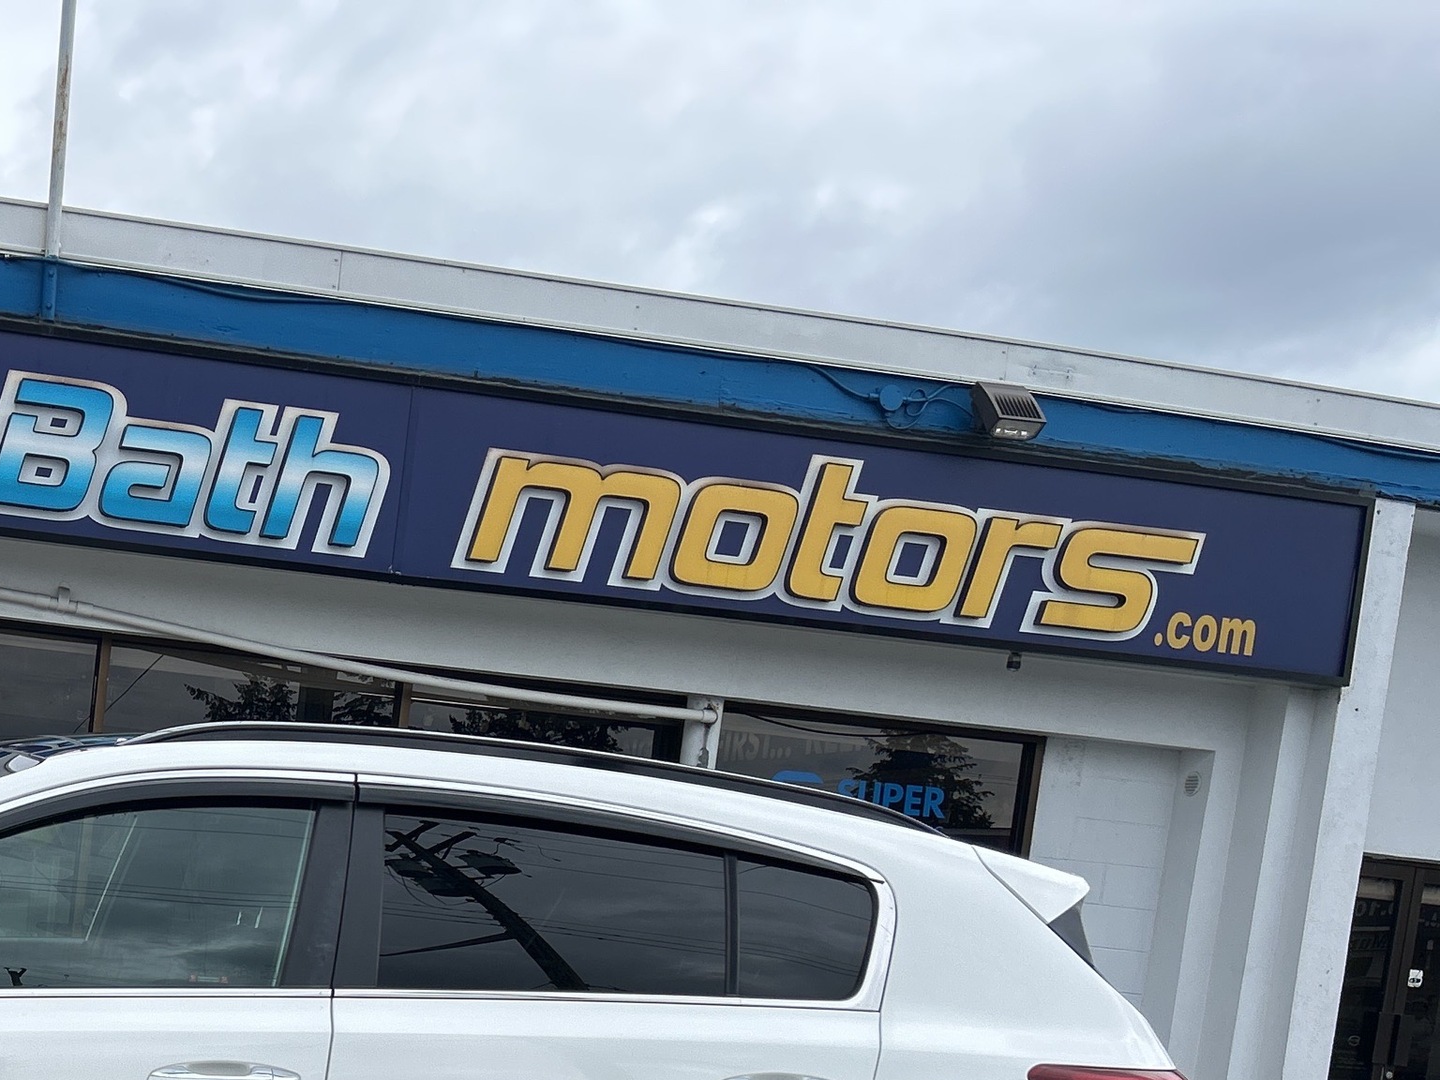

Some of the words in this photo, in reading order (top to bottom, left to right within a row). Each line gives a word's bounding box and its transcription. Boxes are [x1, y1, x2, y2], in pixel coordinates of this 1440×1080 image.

[450, 449, 1207, 642] motors
[1154, 611, 1256, 656] .com
[837, 778, 945, 819] SUPER
